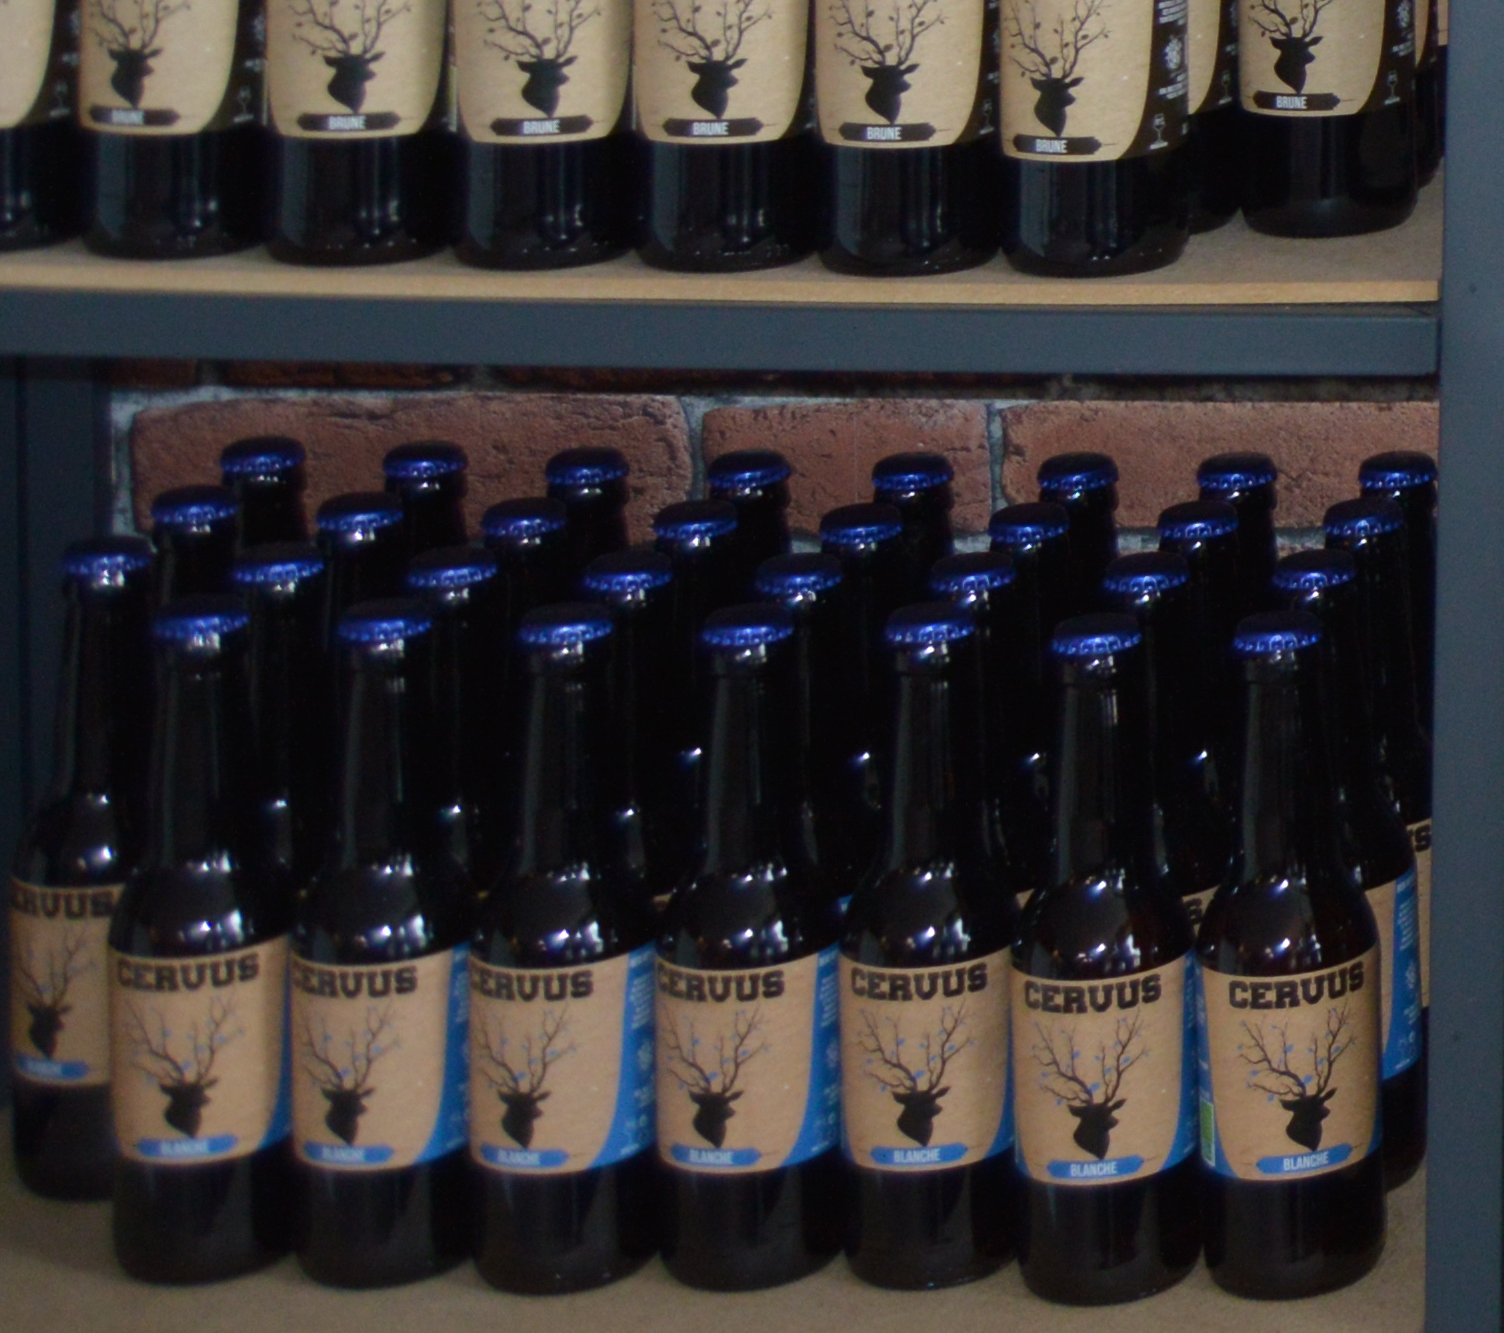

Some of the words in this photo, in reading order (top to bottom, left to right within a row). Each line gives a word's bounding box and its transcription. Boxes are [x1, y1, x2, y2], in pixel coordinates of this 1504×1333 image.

[116, 952, 260, 994] CERVUS
[657, 970, 786, 1005] CERVUS
[850, 962, 989, 1002] CERVUS
[1228, 961, 1365, 1010] CERVUS
[1023, 973, 1163, 1014] CERVUS
[893, 1147, 941, 1164] BLANCHE
[1069, 1159, 1119, 1177] BLANCHE
[1282, 1150, 1330, 1171] BLANCHE
